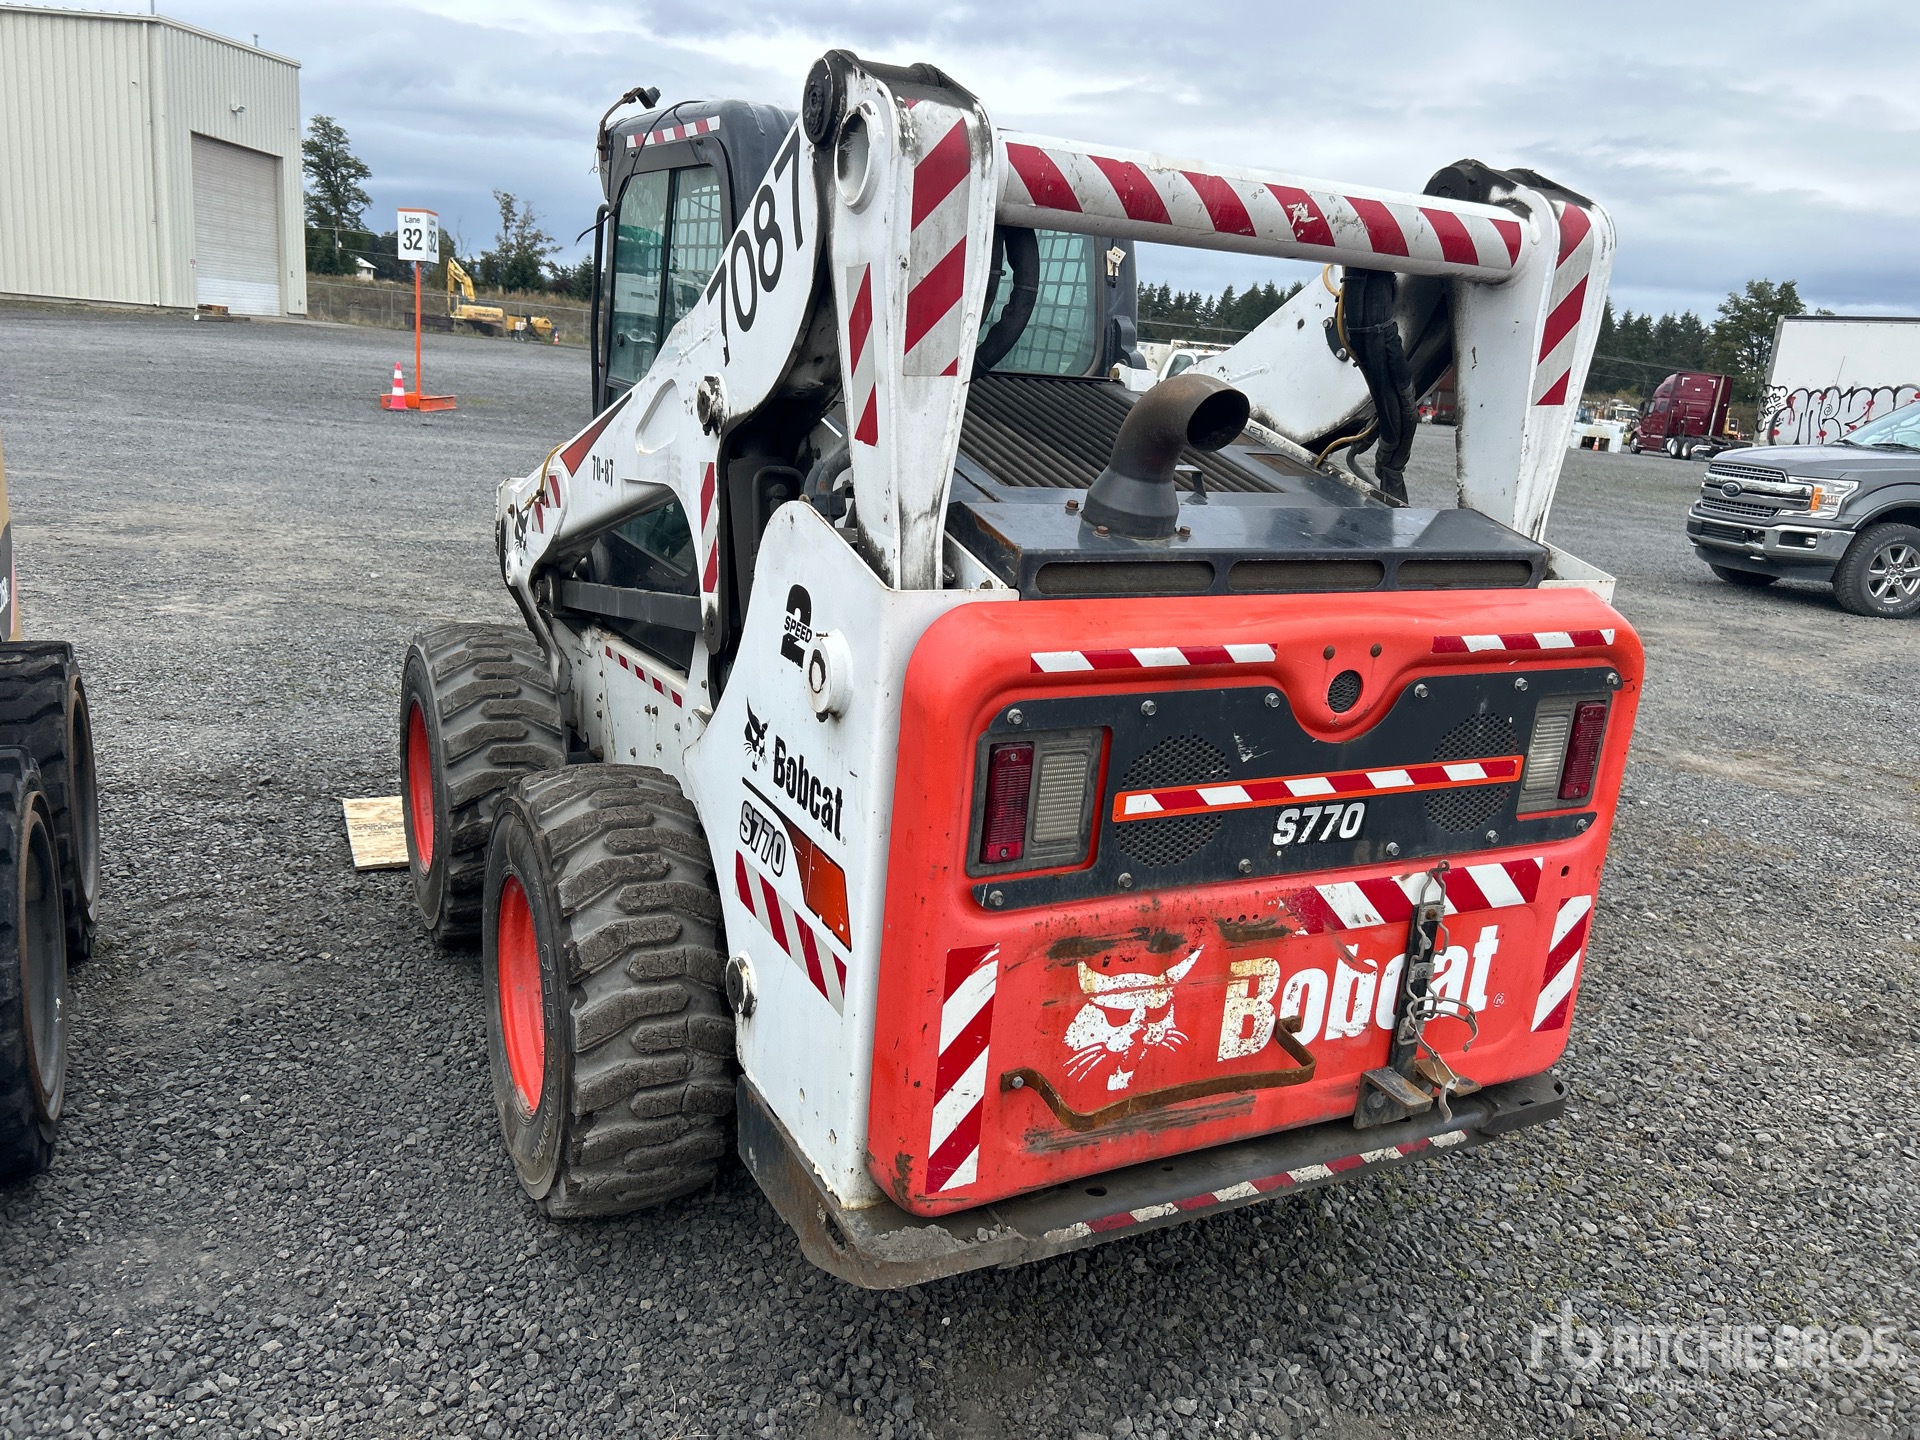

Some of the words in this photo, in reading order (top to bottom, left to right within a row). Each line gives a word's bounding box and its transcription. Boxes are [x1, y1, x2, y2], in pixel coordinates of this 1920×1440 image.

[404, 215, 421, 224] Lane
[402, 228, 423, 250] 32
[428, 230, 437, 253] 32
[707, 125, 804, 368] 7087
[592, 455, 614, 487] 70-87
[780, 584, 812, 669] 2
[784, 615, 812, 643] SPEED
[773, 735, 844, 841] Bobcat
[739, 800, 787, 877] S770
[1272, 802, 1366, 846] S770
